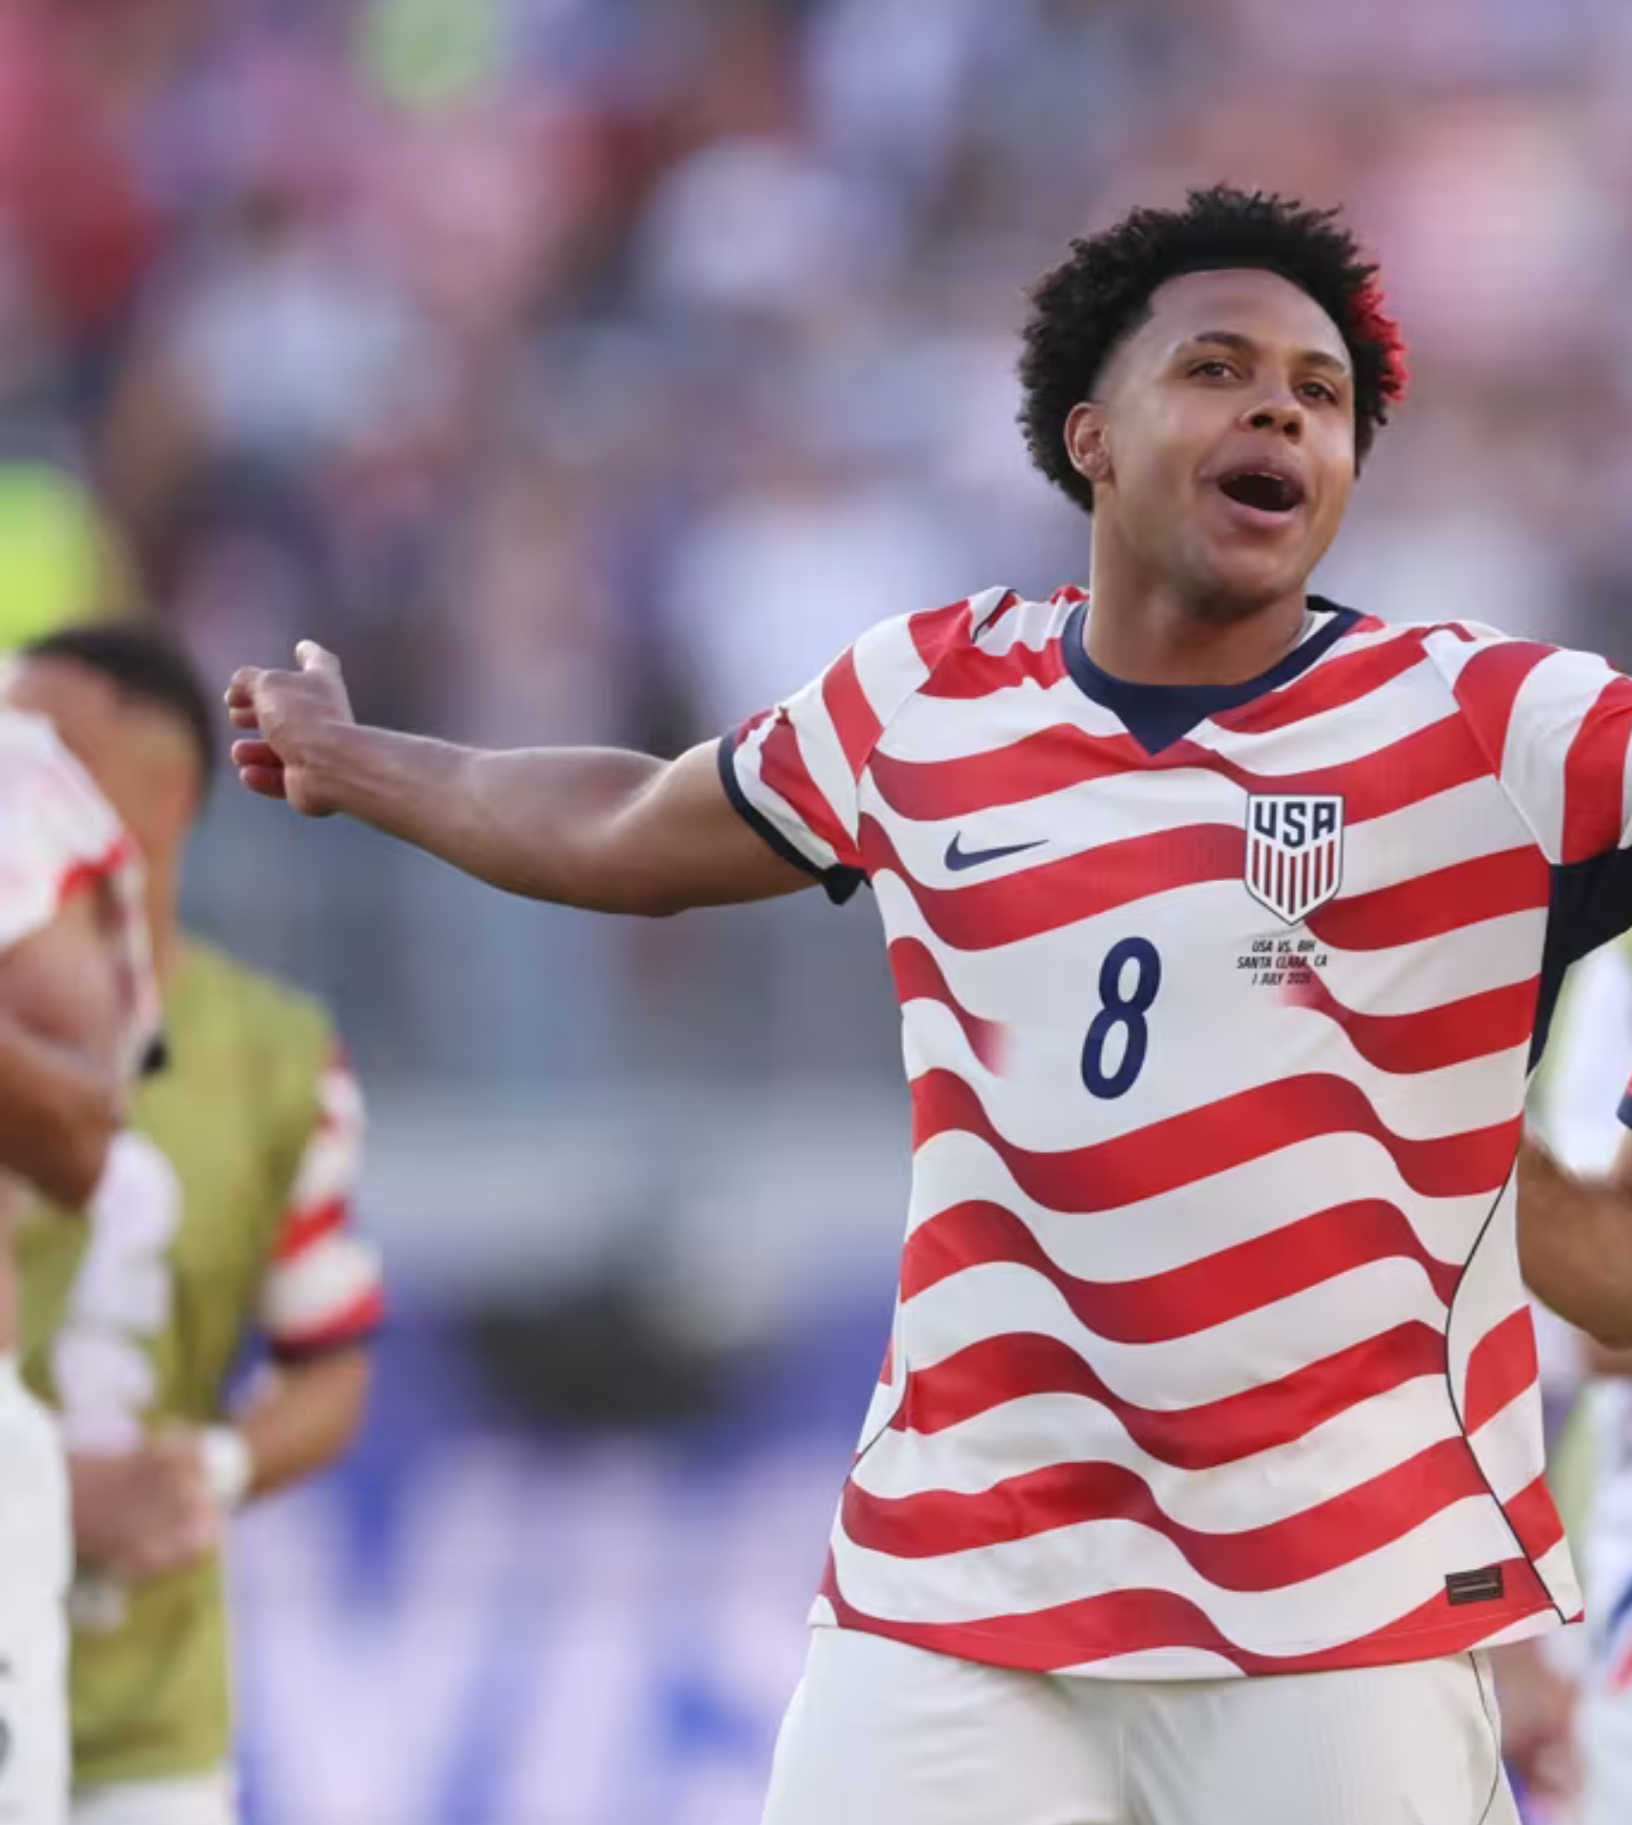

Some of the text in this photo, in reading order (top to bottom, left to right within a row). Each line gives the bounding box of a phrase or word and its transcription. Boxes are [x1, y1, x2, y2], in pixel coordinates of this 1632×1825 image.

[1254, 801, 1337, 848] USA
[1252, 939, 1273, 953] USA
[1237, 955, 1272, 969] SANTA
[1314, 954, 1328, 967] CA
[1259, 972, 1285, 986] JULY
[1080, 936, 1162, 1100] 8
